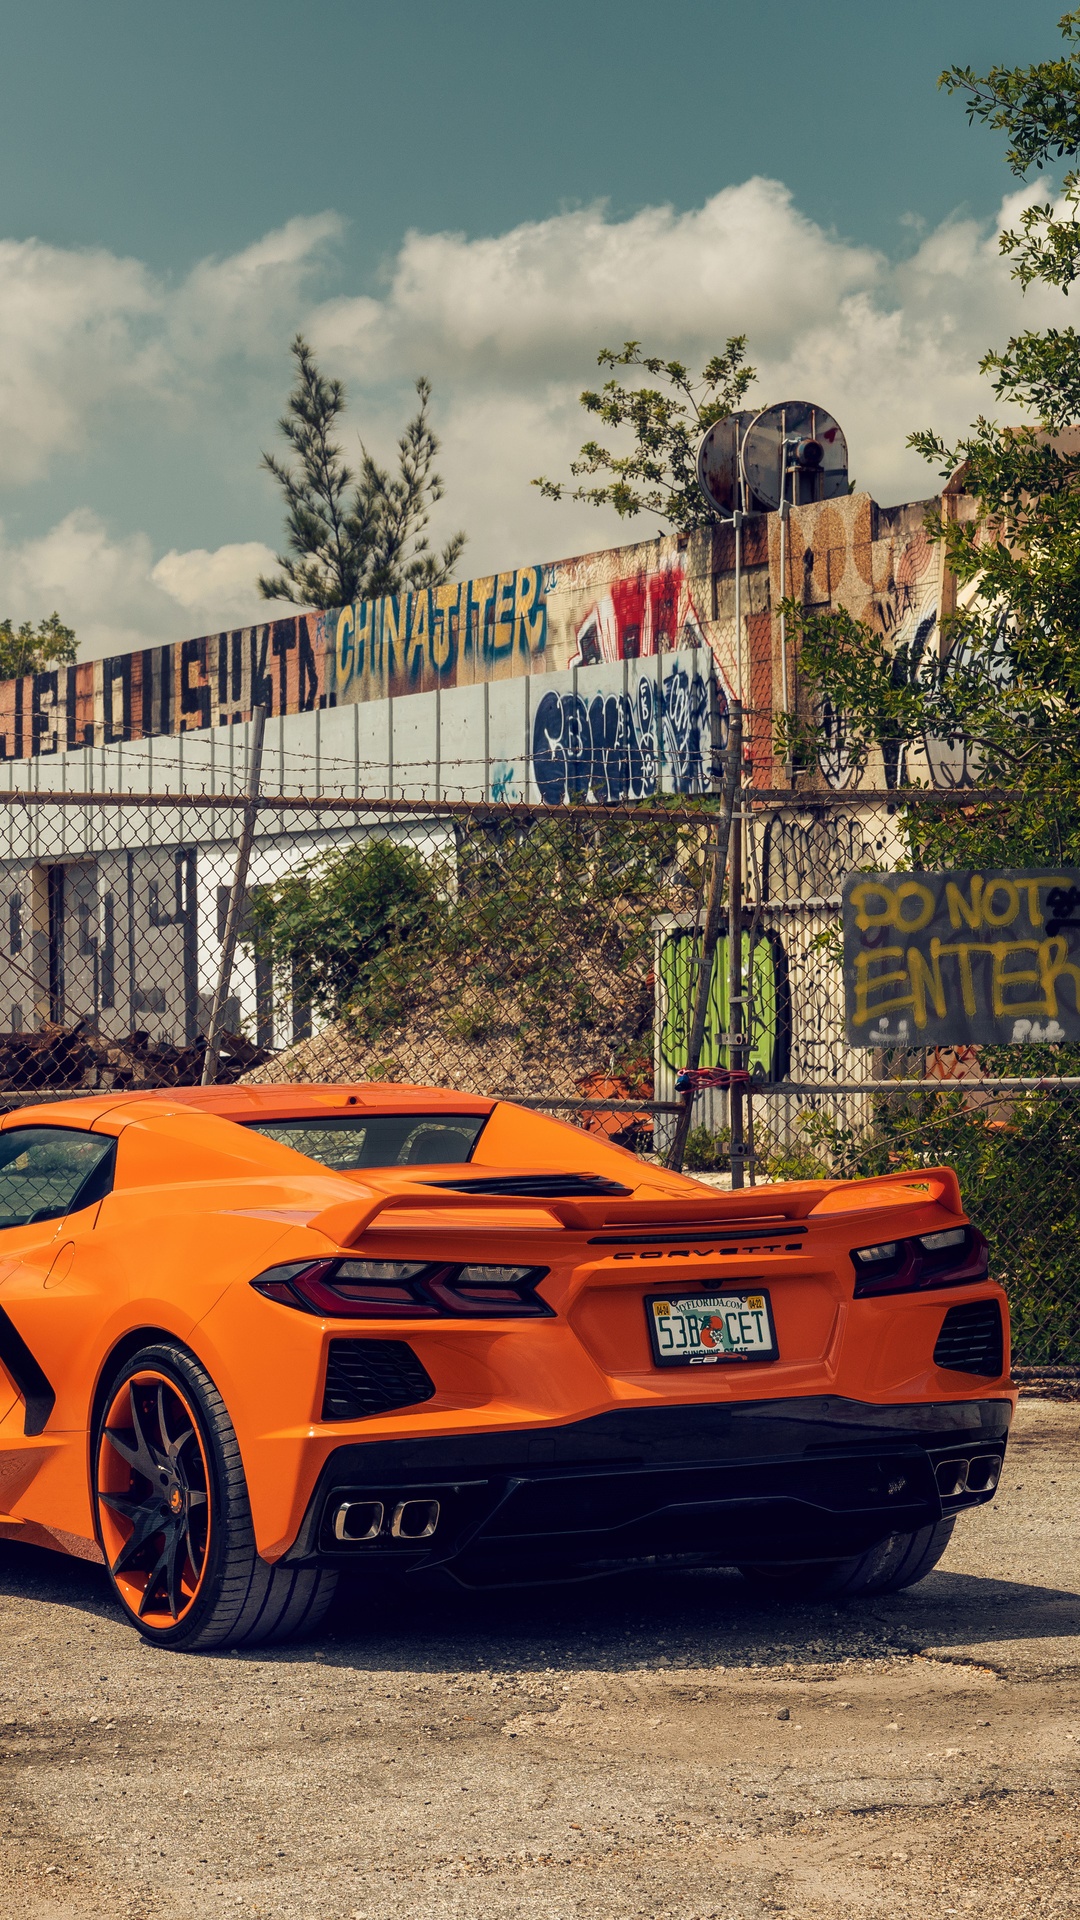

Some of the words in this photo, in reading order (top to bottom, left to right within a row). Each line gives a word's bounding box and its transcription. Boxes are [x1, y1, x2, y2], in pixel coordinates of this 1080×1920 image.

[850, 880, 936, 933] DO
[945, 874, 1074, 929] NOT
[852, 935, 1080, 1029] ENTER
[613, 1243, 803, 1260] CORVETTE
[676, 1298, 743, 1313] MYFLORIDA.COM
[658, 1315, 701, 1349] 53B
[725, 1310, 763, 1345] CET
